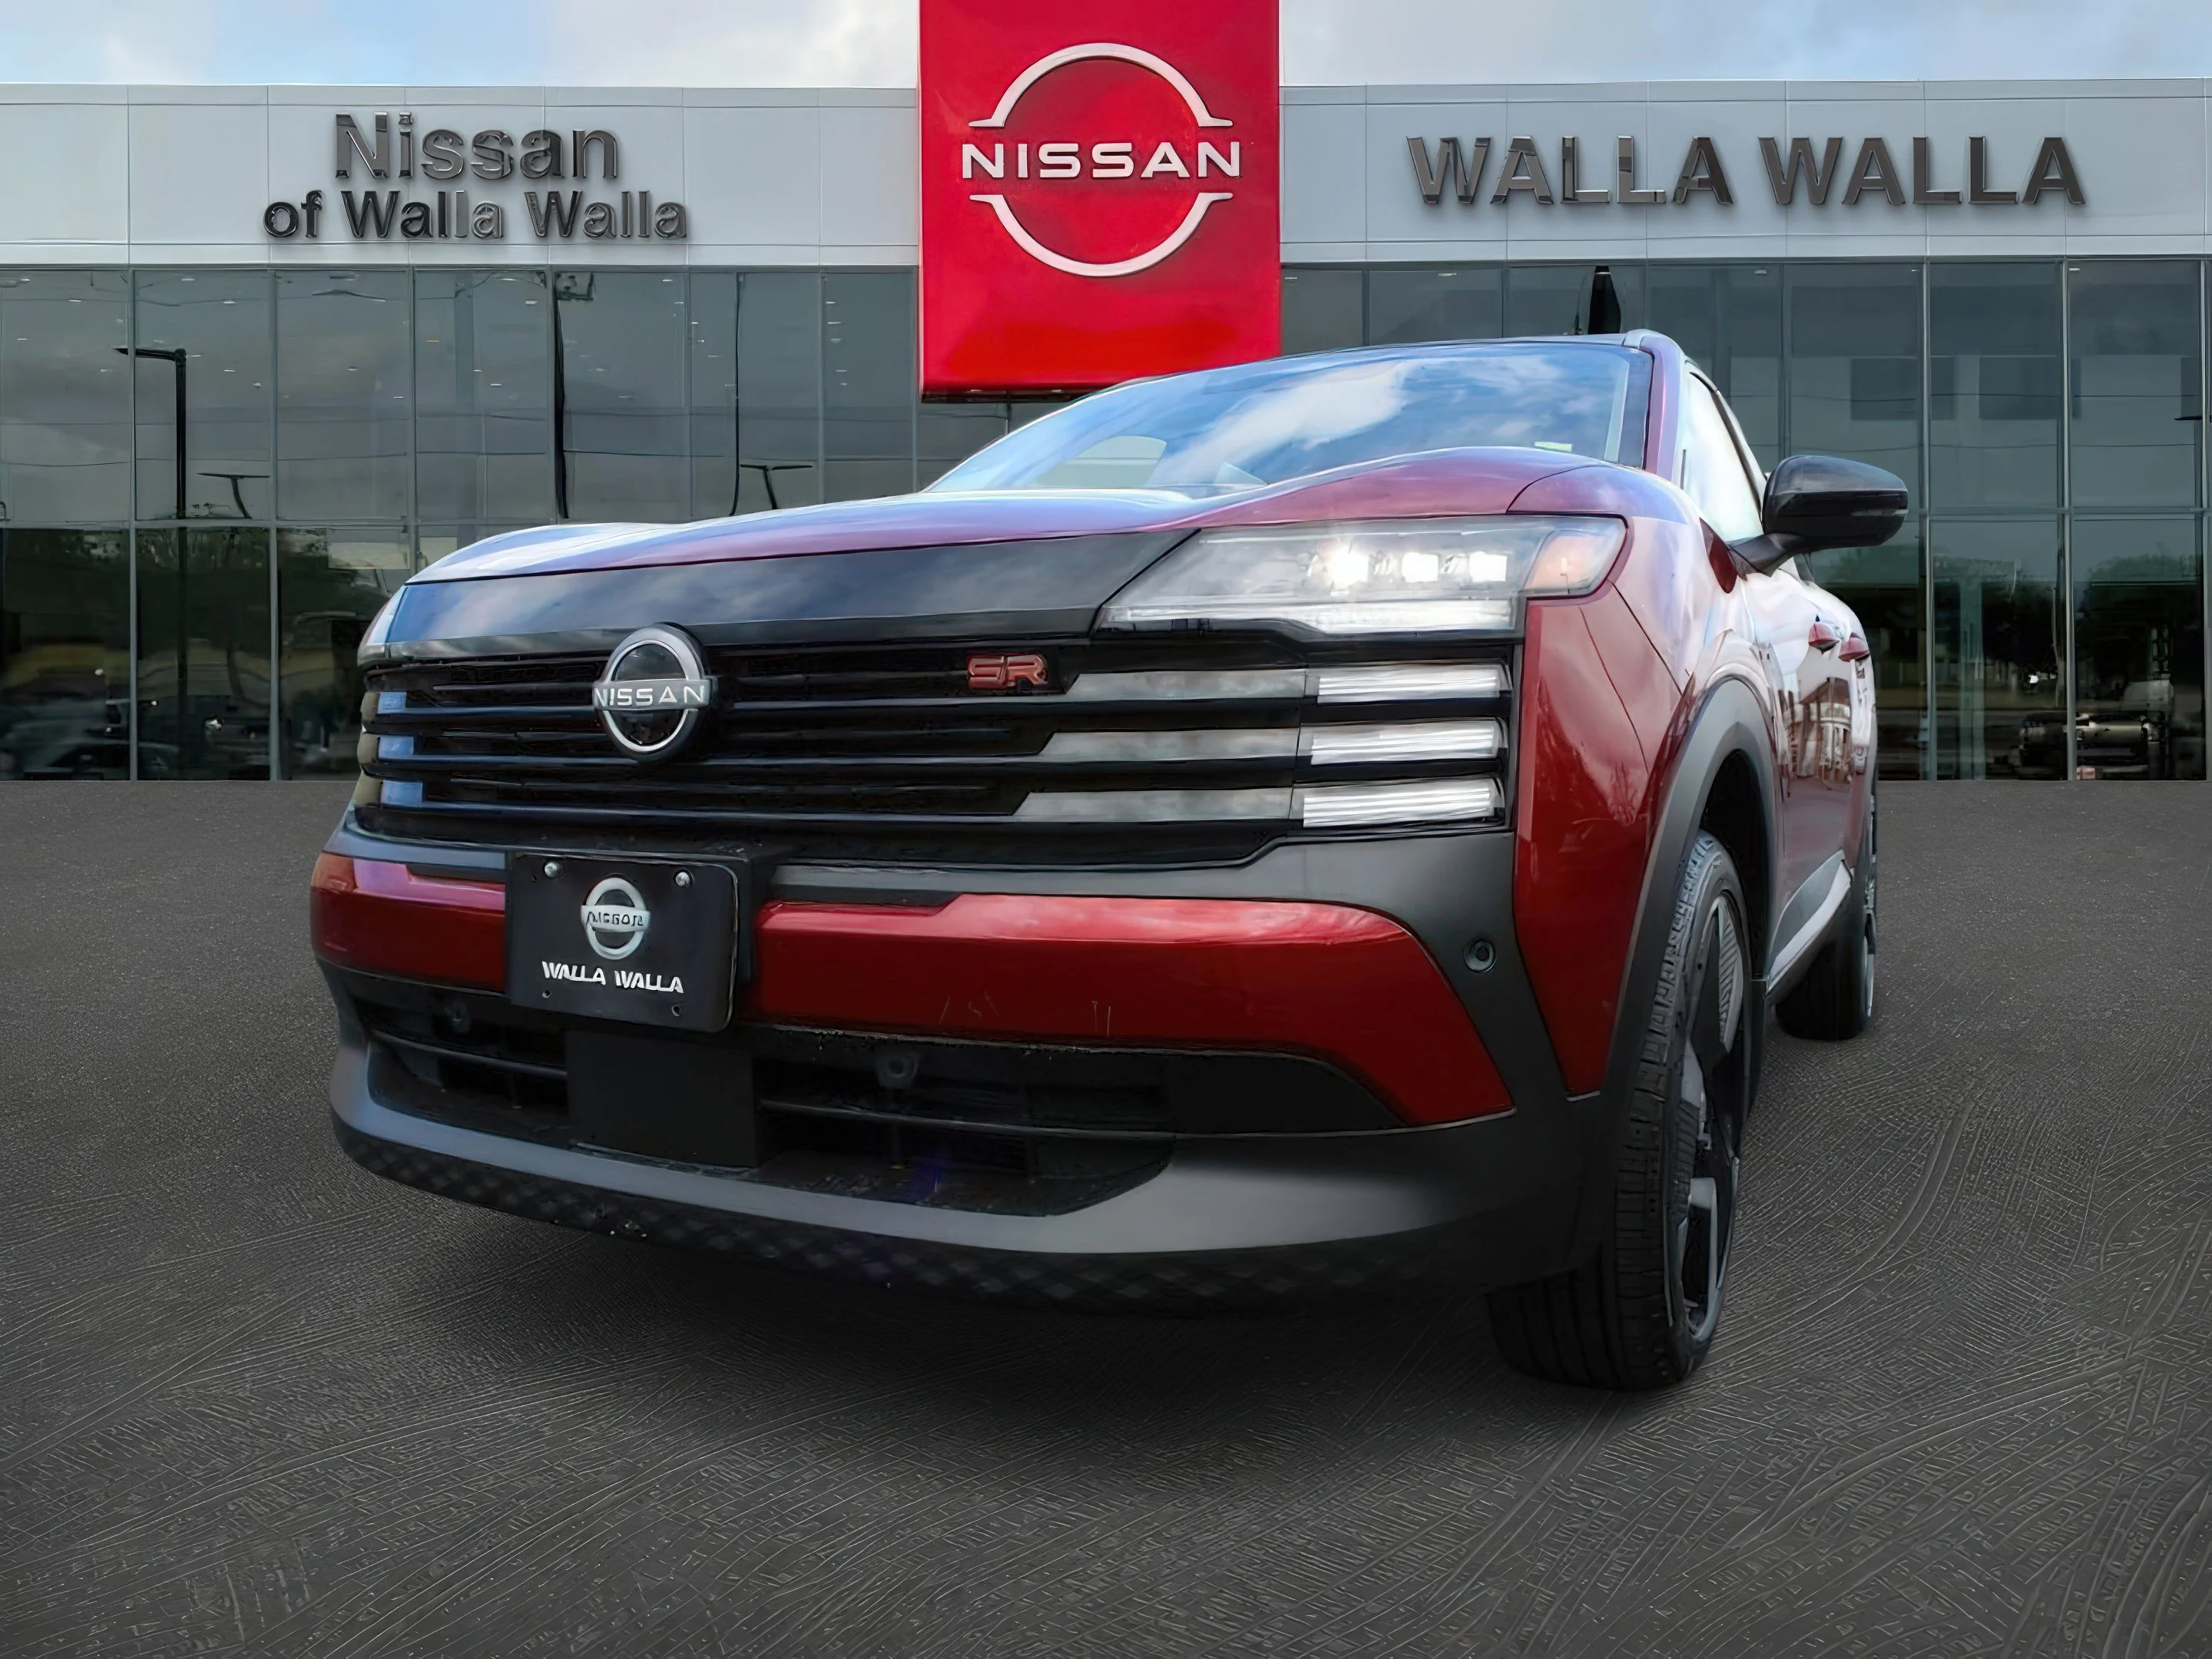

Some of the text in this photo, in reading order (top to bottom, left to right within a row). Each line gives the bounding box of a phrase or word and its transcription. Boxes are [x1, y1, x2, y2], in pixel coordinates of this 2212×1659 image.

[336, 111, 618, 179] Nissan
[962, 141, 1240, 179] NISSAN
[1406, 135, 2087, 206] WALLA WALLA
[263, 190, 687, 238] of Walla Walla
[594, 685, 705, 707] NISSAN
[541, 961, 684, 993] WALLA WALLA
